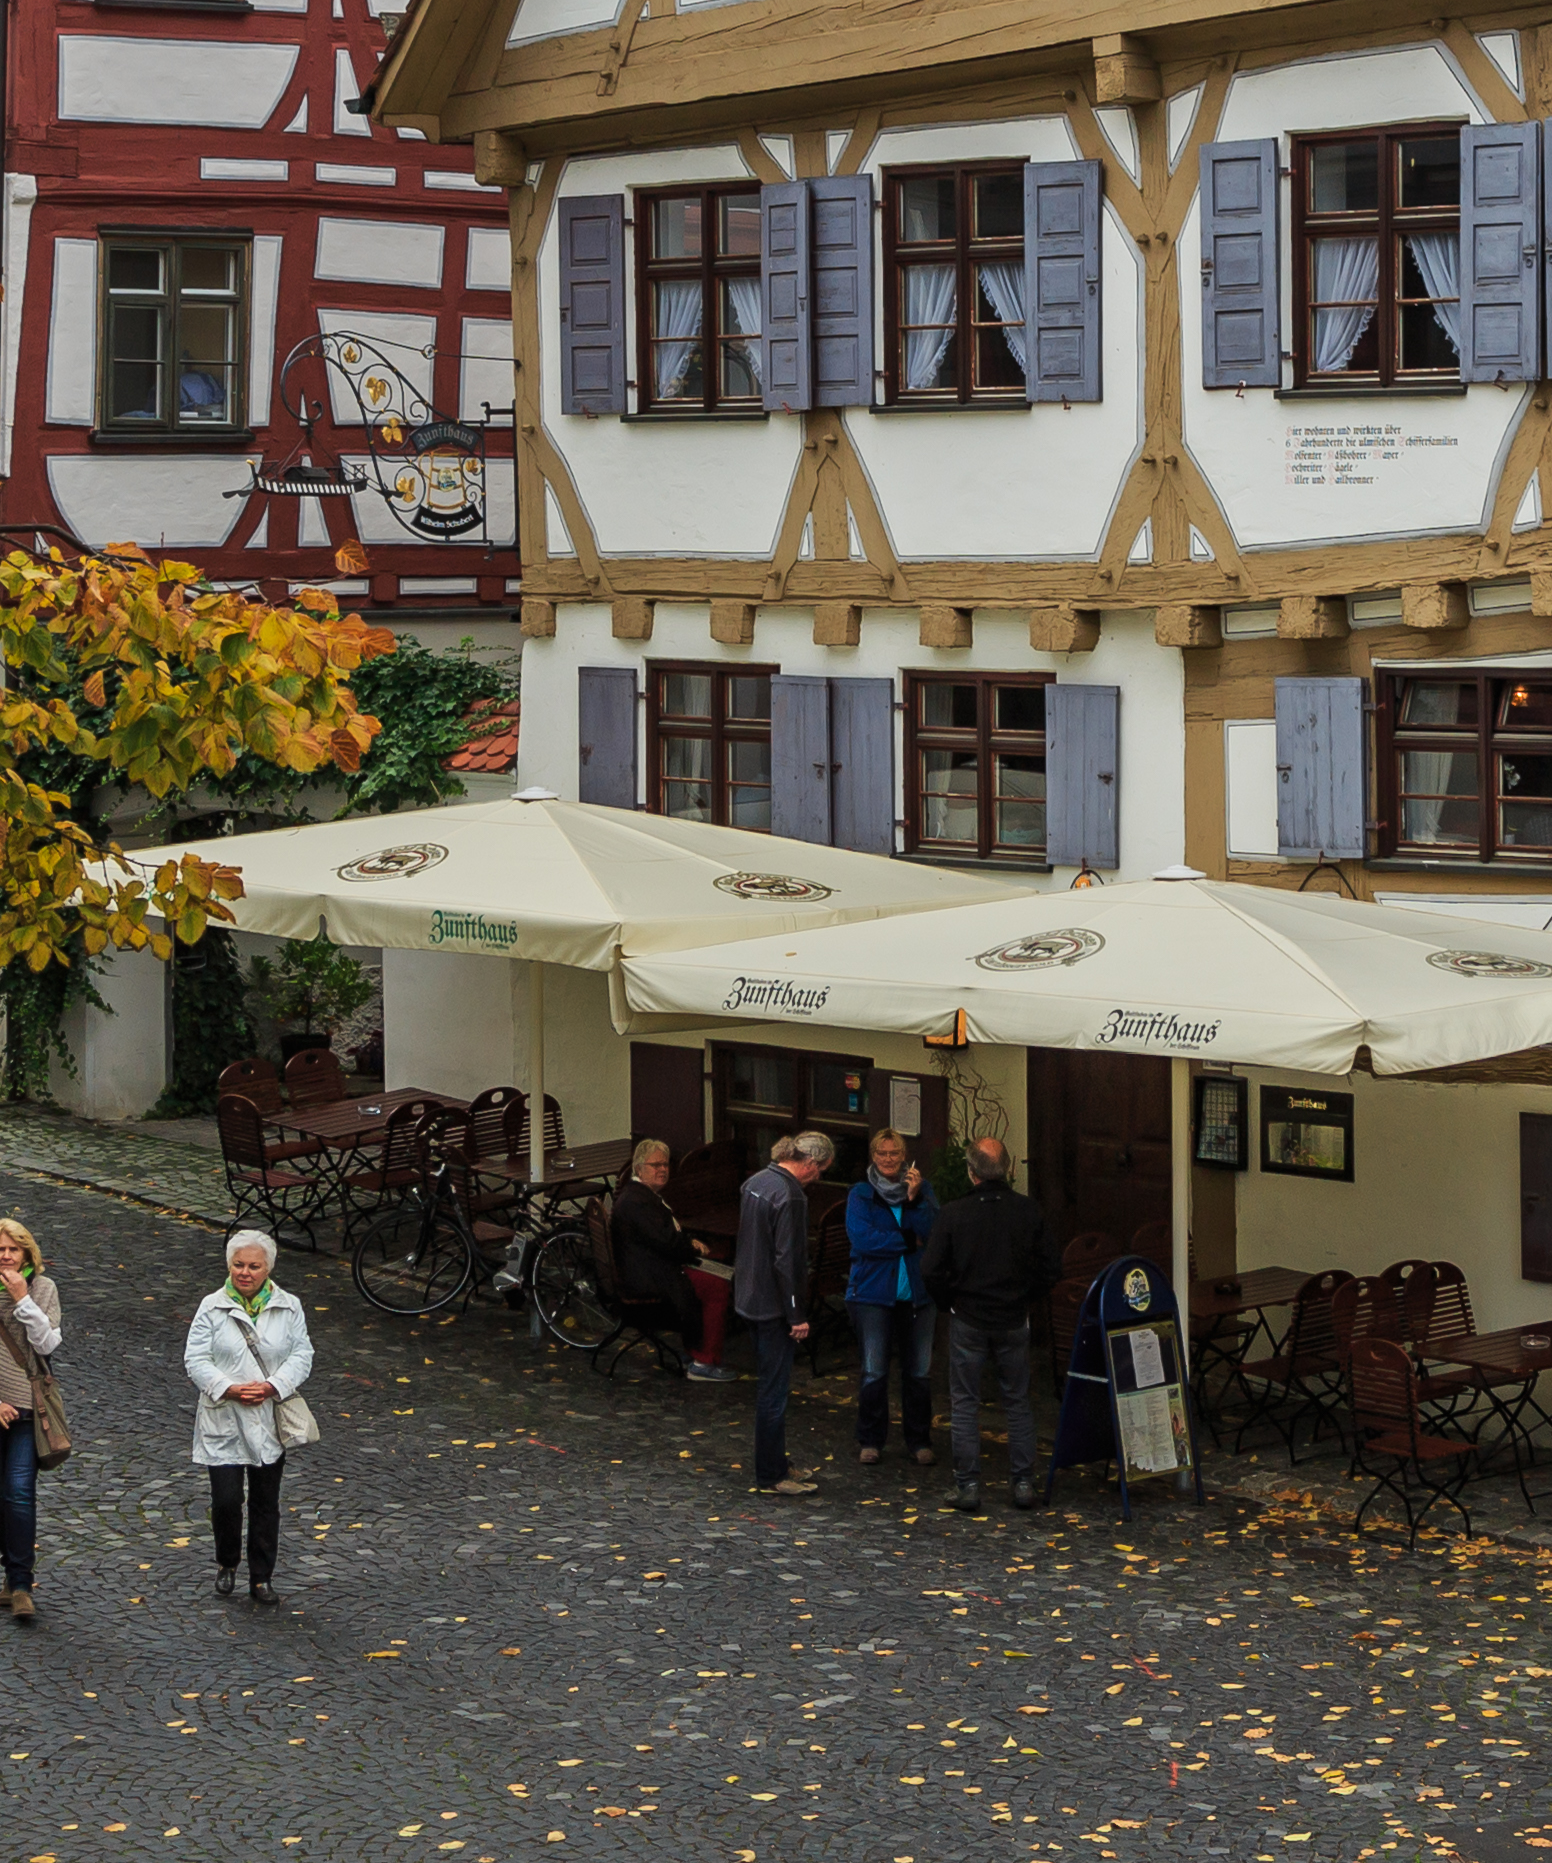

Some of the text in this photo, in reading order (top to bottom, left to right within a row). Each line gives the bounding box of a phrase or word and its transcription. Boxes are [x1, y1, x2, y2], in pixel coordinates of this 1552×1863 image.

[417, 424, 474, 448] Zunfthaus
[1337, 425, 1351, 436] und
[1353, 424, 1382, 435] wirkten
[1385, 424, 1401, 435] über
[1285, 438, 1291, 448] 6
[1293, 437, 1343, 448] Jahrhunderte
[1346, 437, 1356, 447] die
[1312, 474, 1326, 484] und
[428, 909, 518, 949] Zunfthaus
[722, 976, 831, 1013] Zunfthaus
[1094, 1009, 1222, 1048] Zunfthaus
[1287, 1095, 1328, 1110] Zunfthaus
